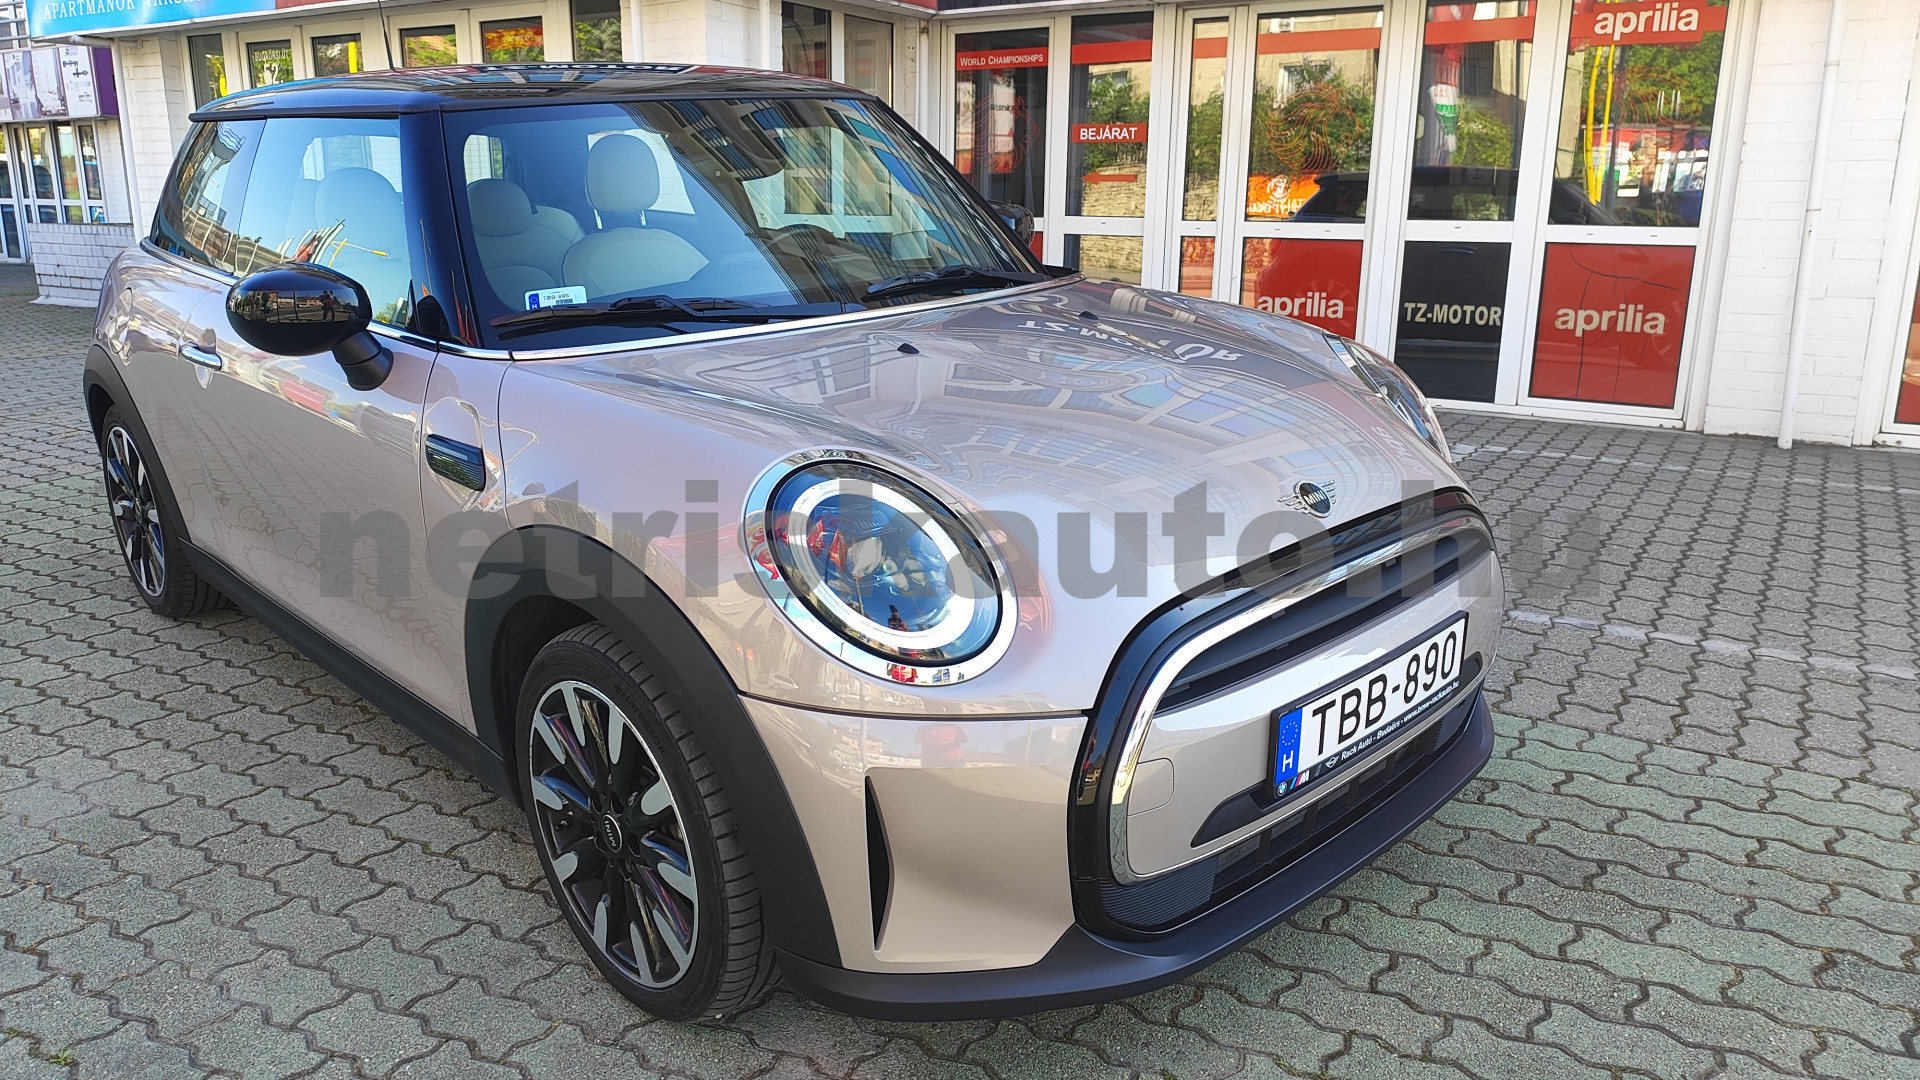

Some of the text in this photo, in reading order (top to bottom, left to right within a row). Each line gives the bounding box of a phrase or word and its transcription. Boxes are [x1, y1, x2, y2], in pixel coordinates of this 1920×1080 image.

[1594, 2, 1699, 41] aprilia
[1080, 126, 1137, 140] BEJÁRAT
[1256, 292, 1344, 319] aprilia
[1404, 303, 1502, 326] TZ-MOTOR
[1554, 303, 1666, 337] aprilia
[1303, 489, 1327, 506] MINI
[1312, 630, 1458, 756] TBB-890
[1281, 749, 1294, 773] H
[604, 820, 617, 847] MINI
